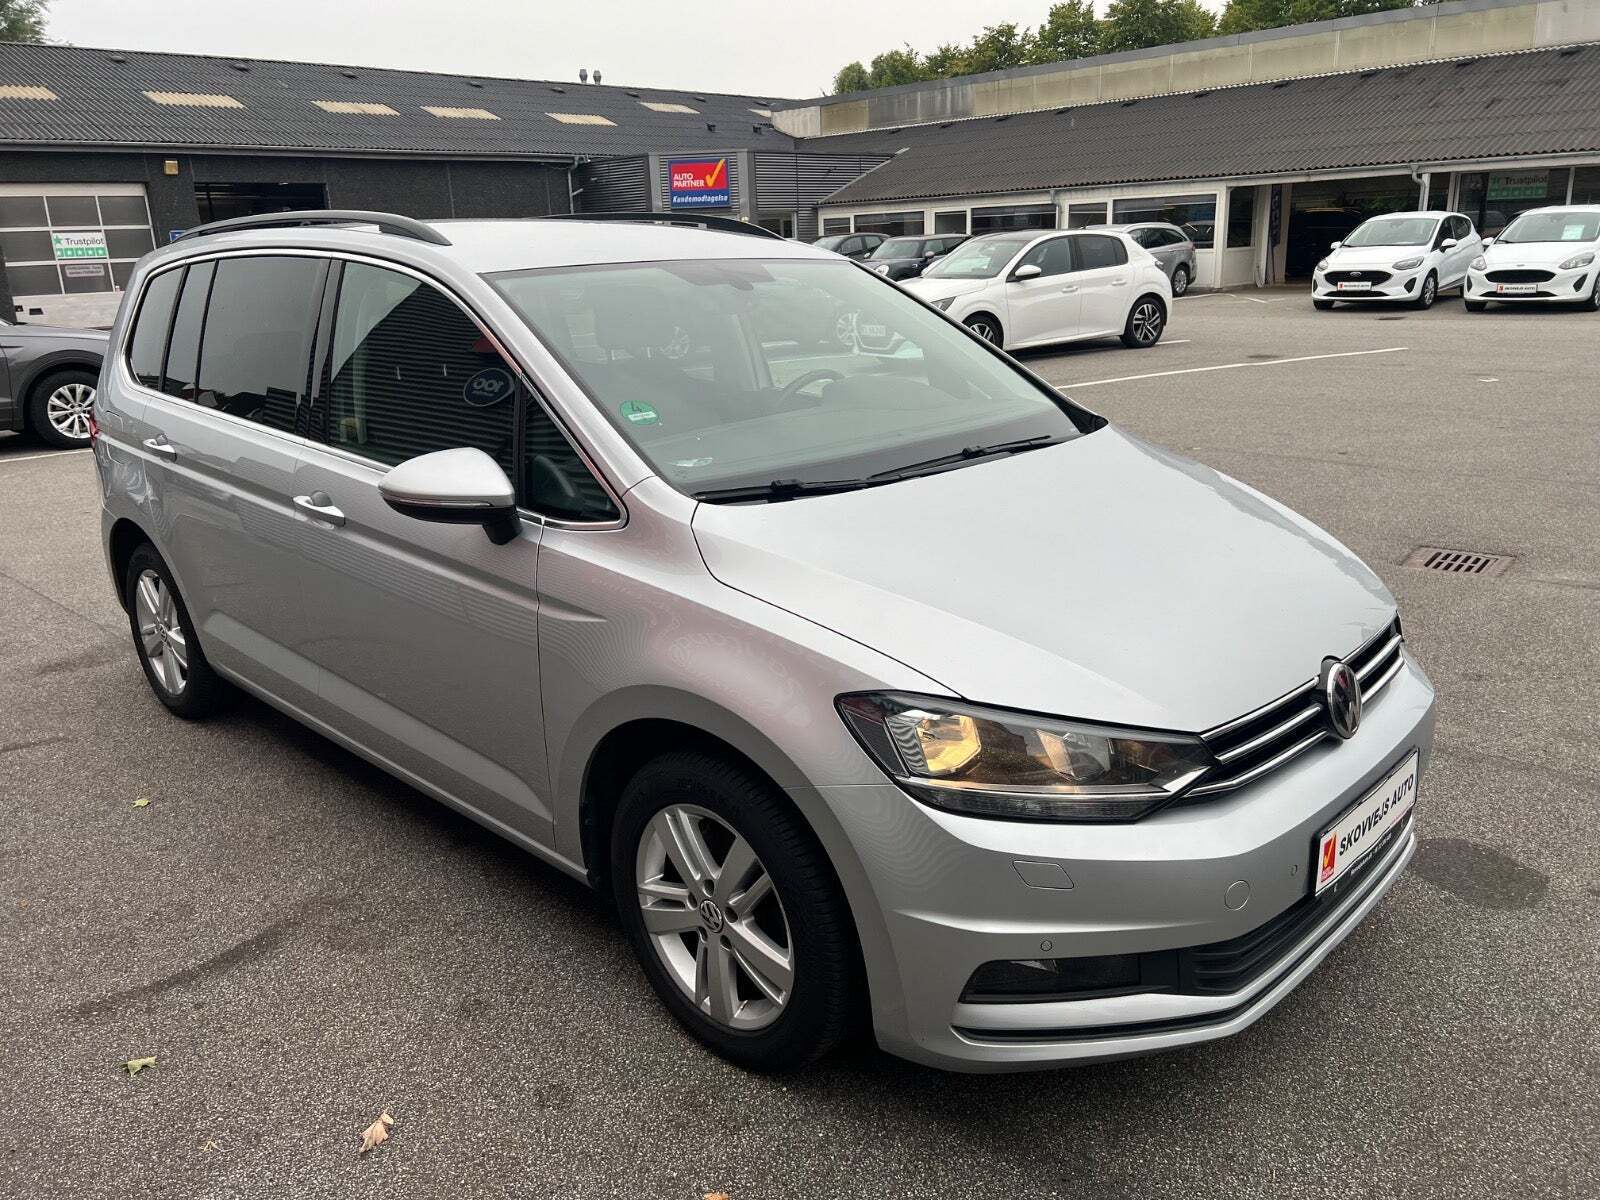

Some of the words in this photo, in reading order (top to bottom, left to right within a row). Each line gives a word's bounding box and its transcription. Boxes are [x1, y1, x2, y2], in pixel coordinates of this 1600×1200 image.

[64, 237, 105, 246] Trustpilot
[1339, 797, 1390, 857] SKOVVEJS
[1391, 773, 1414, 809] AUTO
